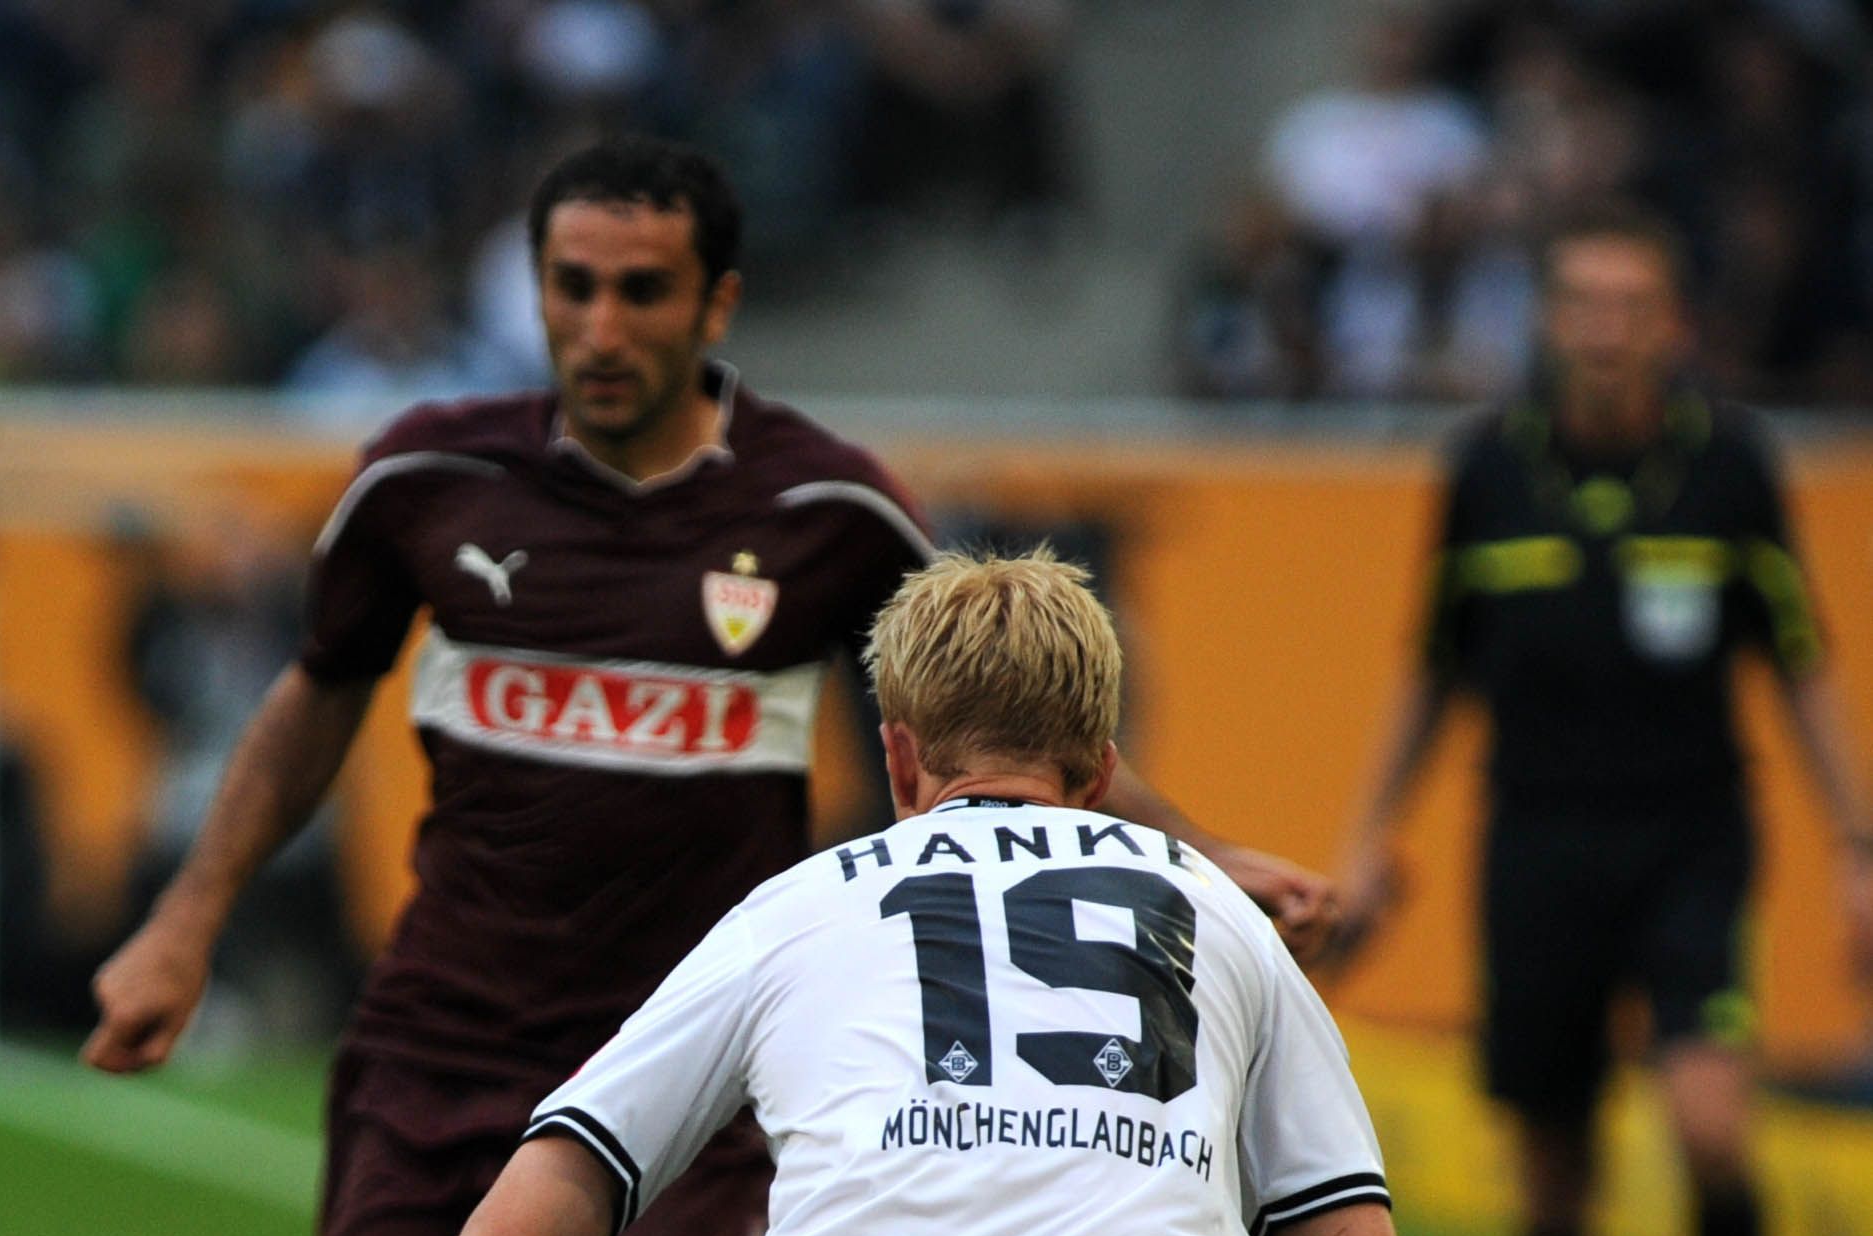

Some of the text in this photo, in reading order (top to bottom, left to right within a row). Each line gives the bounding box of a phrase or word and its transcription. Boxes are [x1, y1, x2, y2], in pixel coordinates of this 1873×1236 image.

[483, 664, 730, 751] GAZI
[879, 866, 1199, 1104] 19
[881, 1098, 1213, 1183] MÖNCHENGLADBACH
